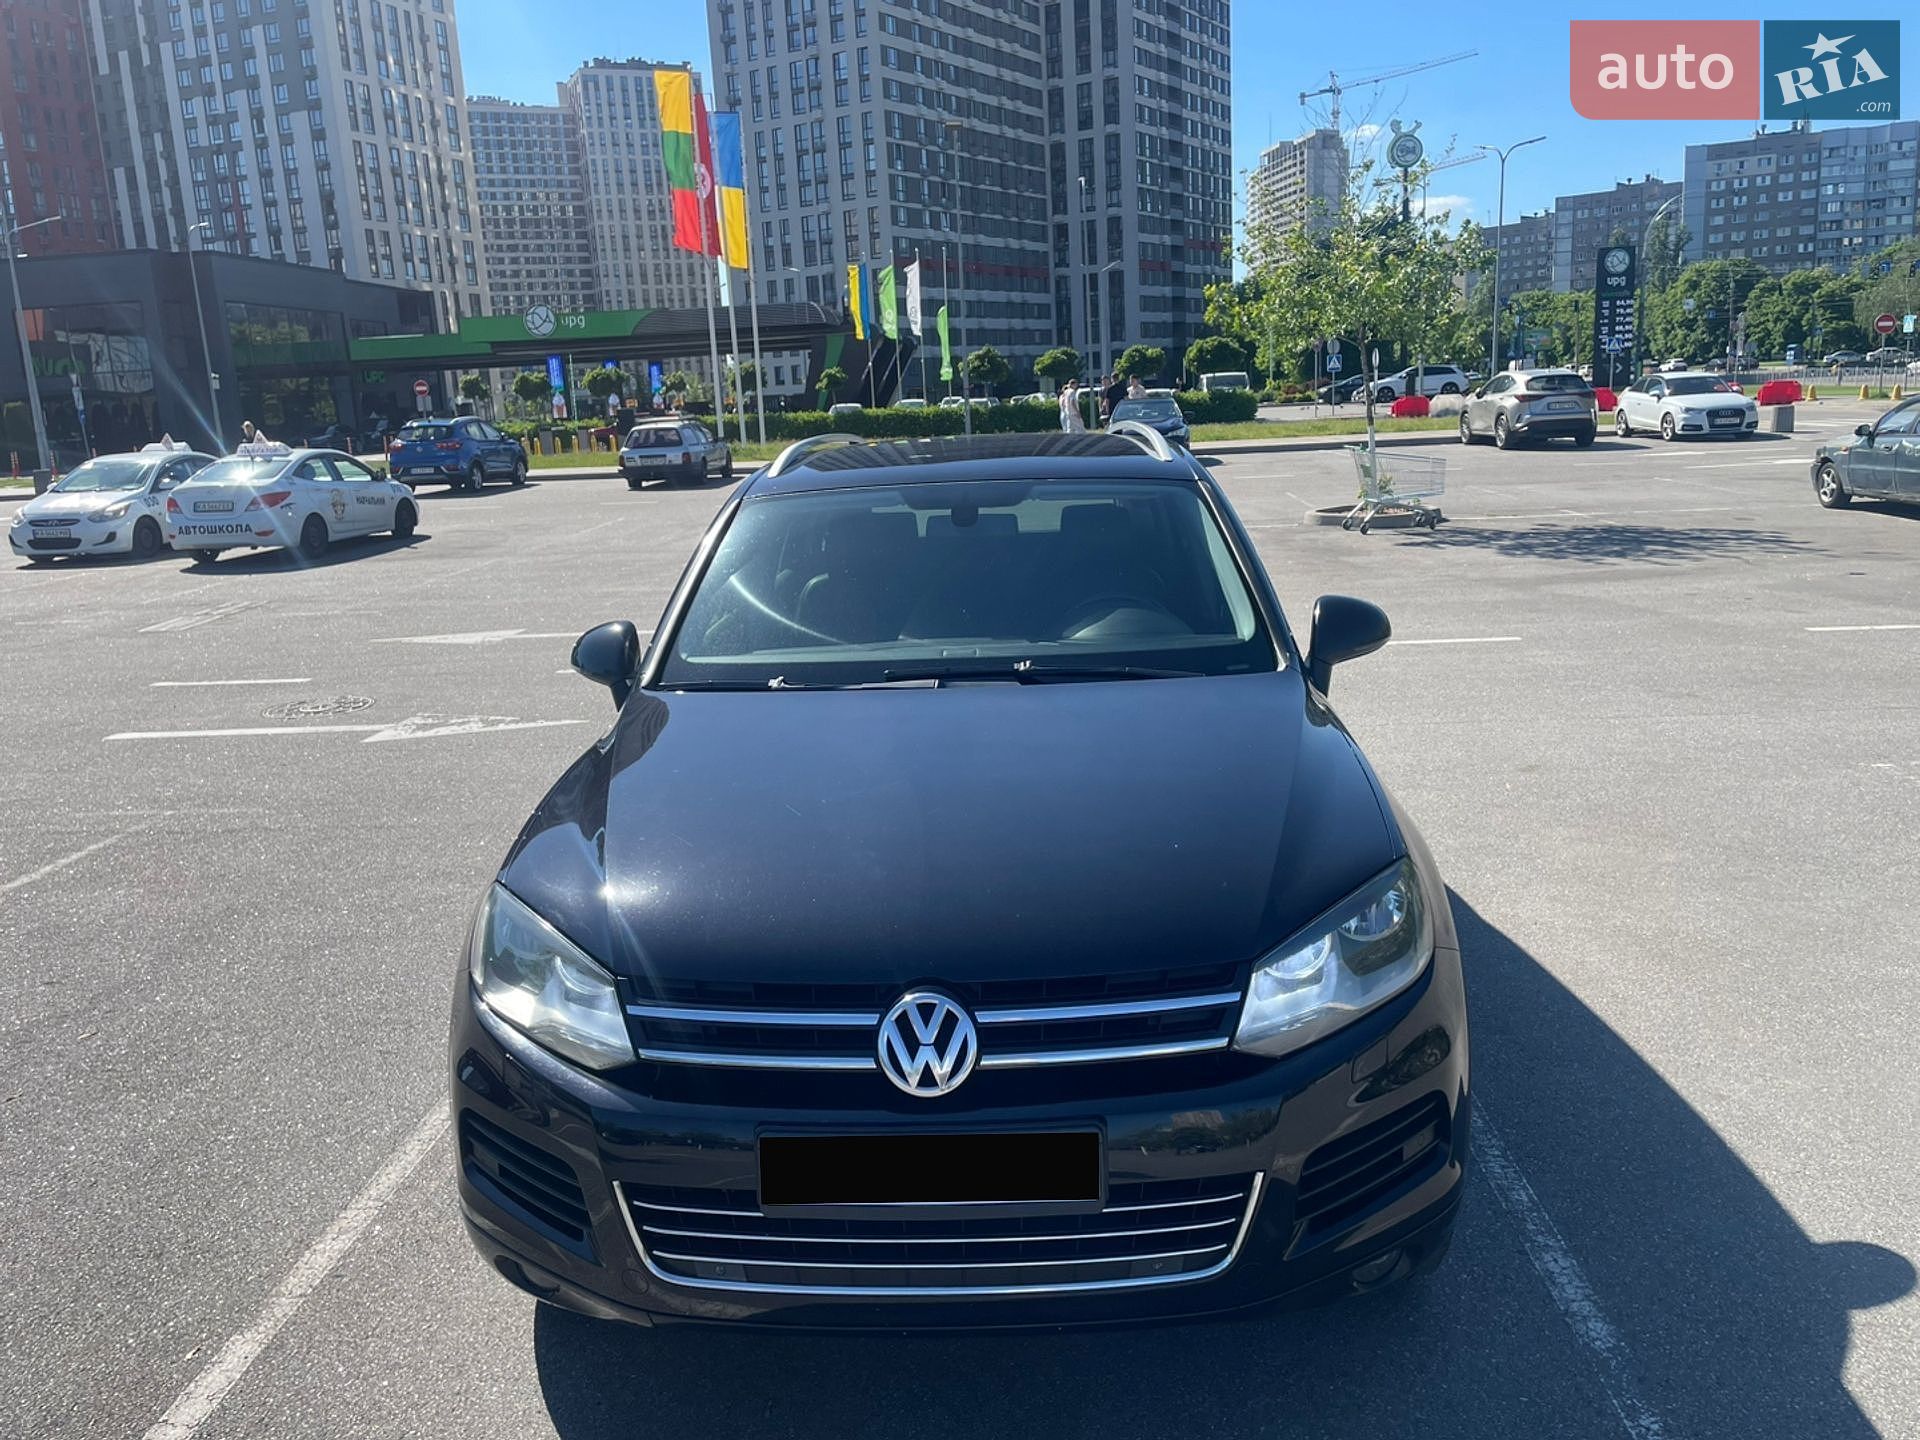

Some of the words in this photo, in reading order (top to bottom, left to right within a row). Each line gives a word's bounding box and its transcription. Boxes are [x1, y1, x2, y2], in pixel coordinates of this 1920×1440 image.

[1606, 276, 1626, 287] upg
[561, 315, 585, 328] upg
[178, 524, 253, 536] АВТОШКОЛА
